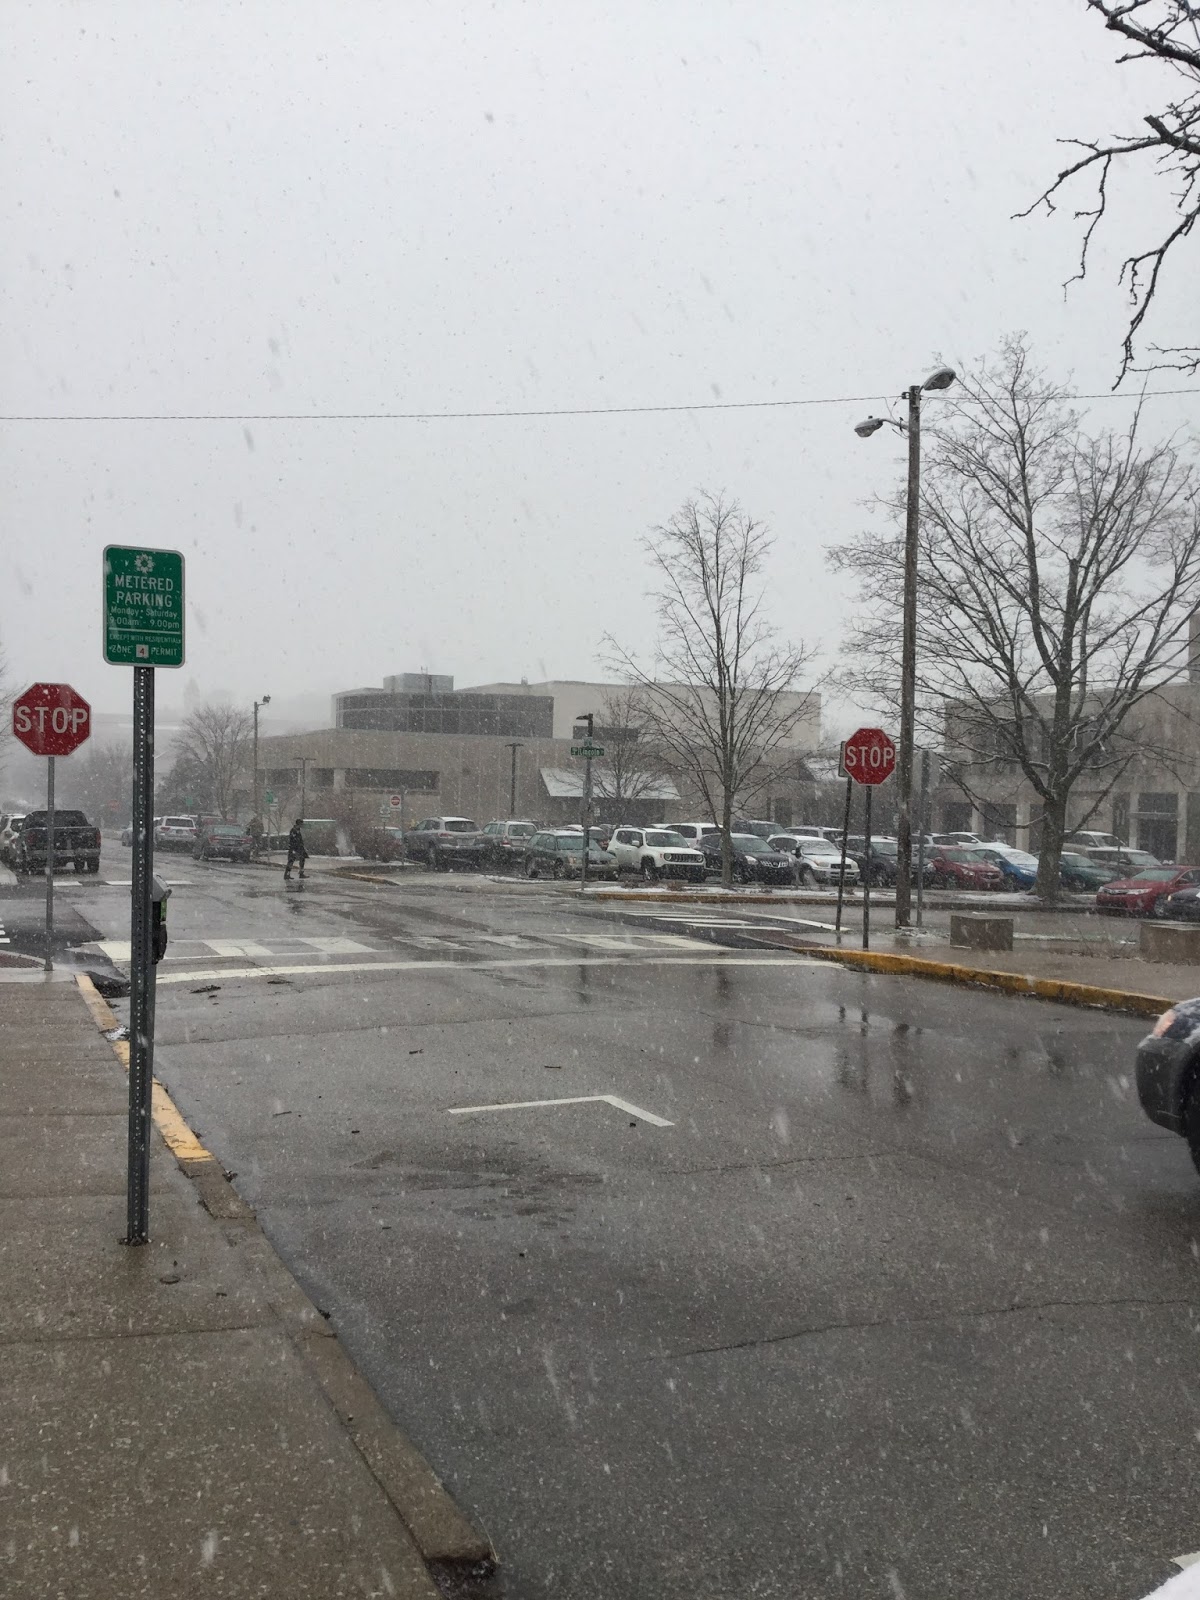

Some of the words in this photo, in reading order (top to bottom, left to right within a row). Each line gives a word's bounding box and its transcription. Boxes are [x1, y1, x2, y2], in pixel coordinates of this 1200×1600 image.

[115, 574, 173, 591] METERED
[116, 591, 172, 607] PARKING
[110, 606, 139, 617] Monday
[146, 608, 177, 619] Saturday
[111, 644, 132, 654] ZONE
[151, 647, 177, 656] PERMIT
[15, 705, 88, 734] STOP
[846, 745, 894, 768] STOP
